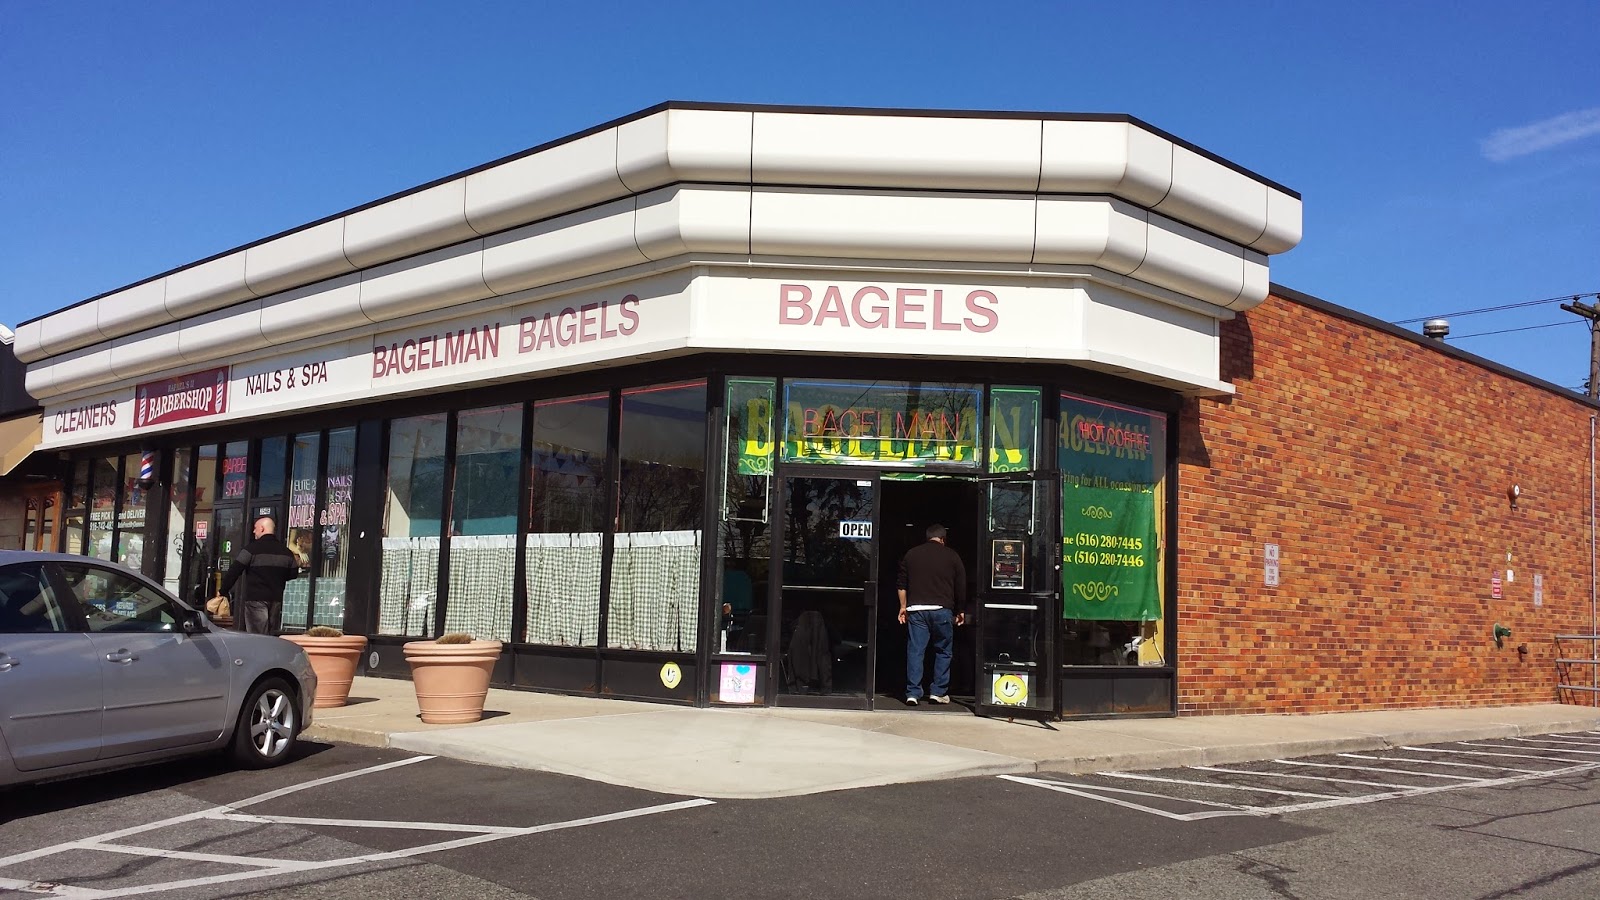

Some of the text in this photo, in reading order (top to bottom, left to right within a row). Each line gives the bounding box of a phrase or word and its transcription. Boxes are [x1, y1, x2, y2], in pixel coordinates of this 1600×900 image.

[779, 284, 999, 333] BAGELS
[373, 294, 640, 378] BAGELMAN BAGELS
[246, 361, 328, 397] NAILS & SPA
[148, 387, 212, 422] BARBERSHOP
[55, 400, 116, 434] CLEANERS
[1059, 411, 1146, 460] AGELMAN
[1078, 421, 1150, 452] HOT COFFEE
[223, 457, 247, 473] BARBE
[226, 480, 245, 496] SHOP
[328, 475, 352, 488] NAILS
[1063, 470, 1079, 488] ring
[1081, 473, 1092, 486] for
[1093, 477, 1109, 489] ALL
[335, 490, 352, 502] SPA
[90, 512, 101, 521] FREE
[127, 509, 145, 519] DELIVER
[289, 502, 346, 528] NAILS & SPA
[843, 523, 871, 537] OPEN
[1063, 532, 1143, 550] ne (516) 280-7445
[1063, 551, 1144, 567] ax (516) 280-7446
